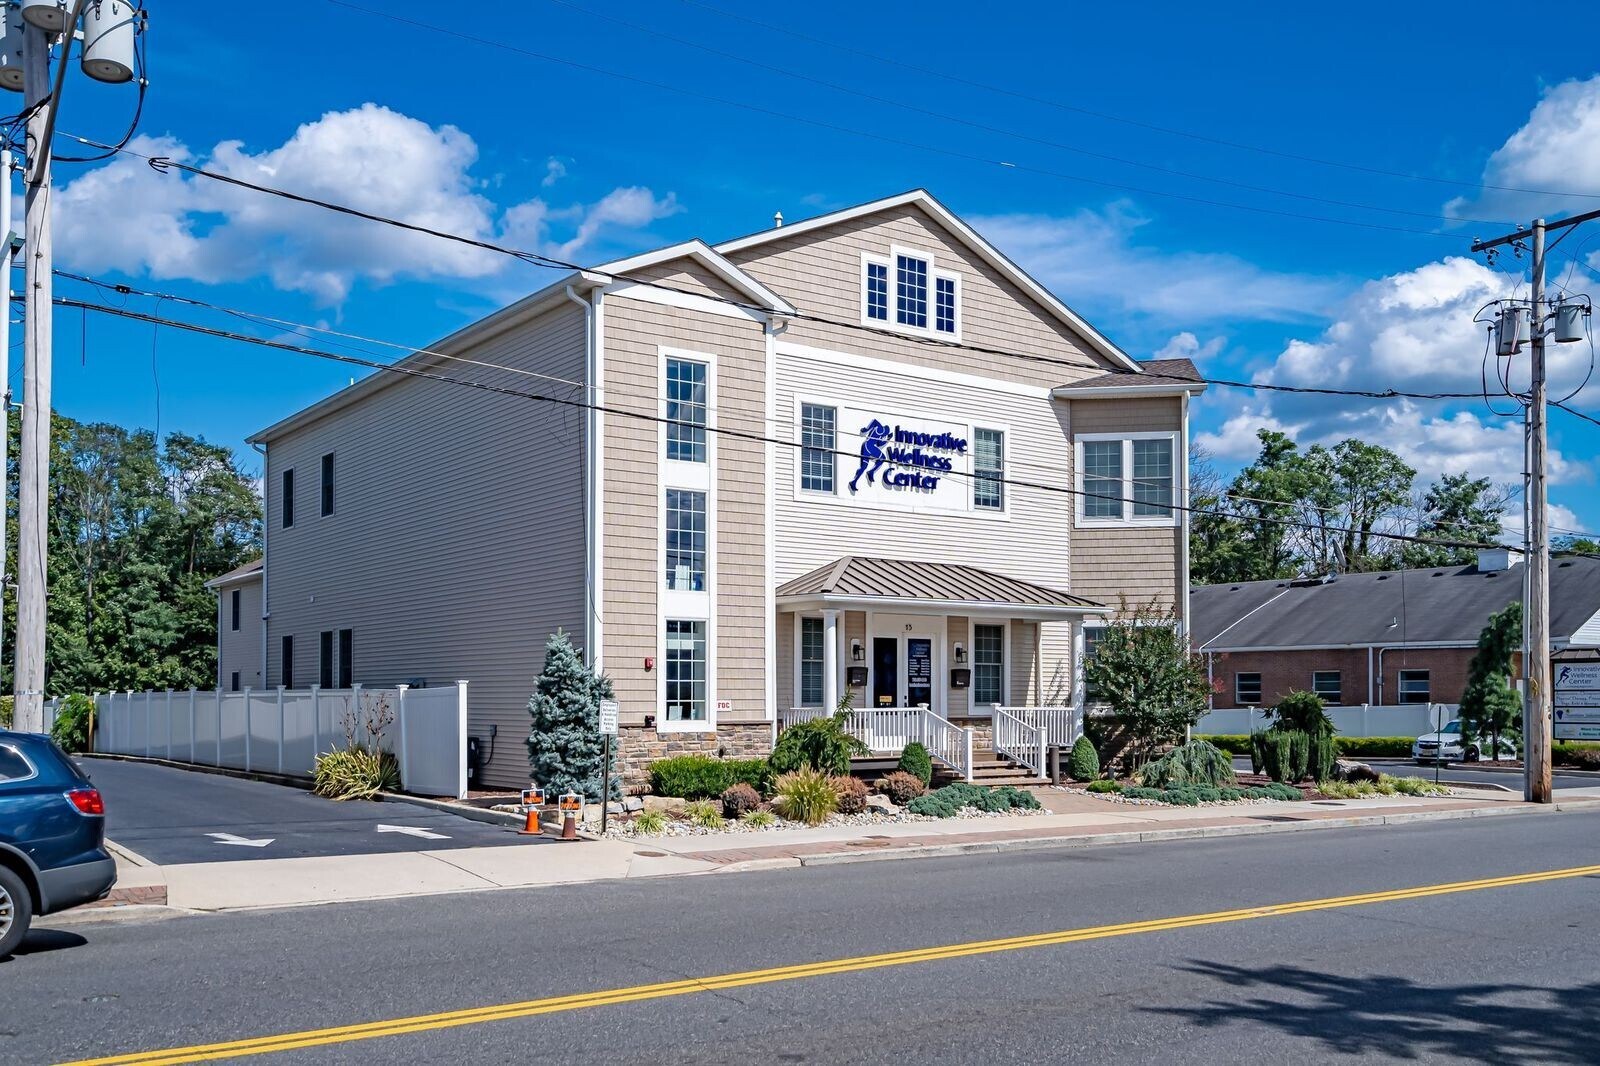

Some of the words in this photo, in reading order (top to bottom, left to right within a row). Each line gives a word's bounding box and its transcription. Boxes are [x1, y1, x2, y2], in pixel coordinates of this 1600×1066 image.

[894, 425, 968, 453] Innovative
[886, 446, 953, 471] Wellness
[882, 467, 941, 490] Center
